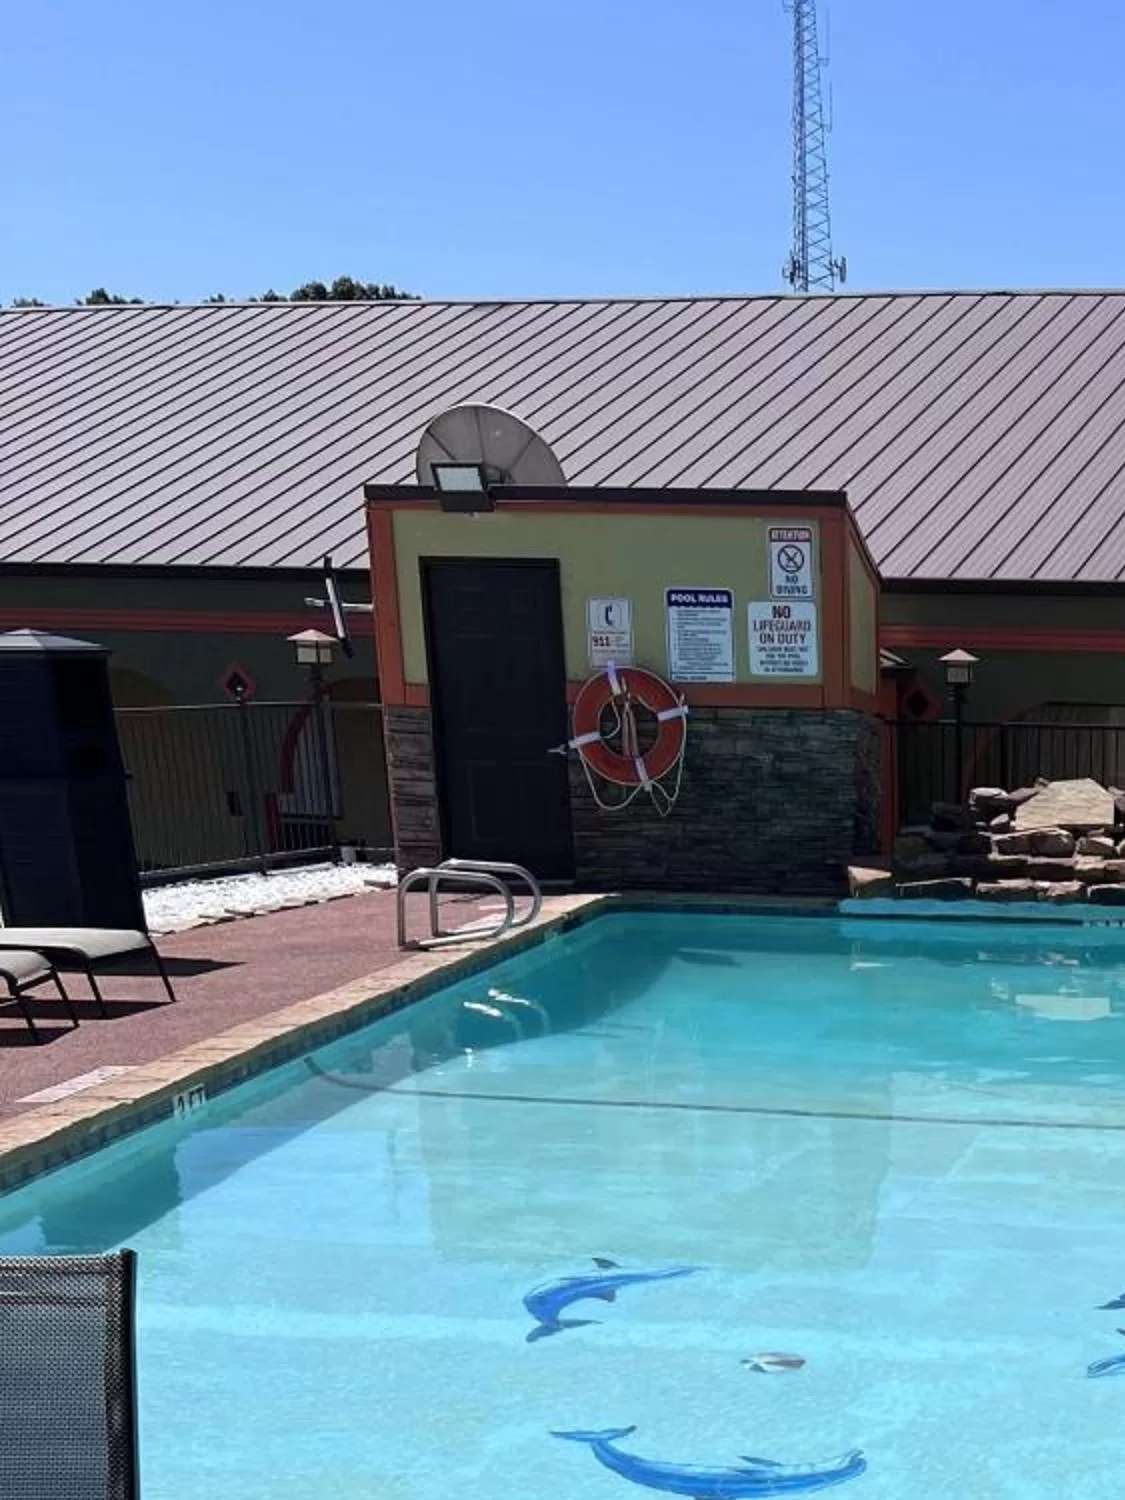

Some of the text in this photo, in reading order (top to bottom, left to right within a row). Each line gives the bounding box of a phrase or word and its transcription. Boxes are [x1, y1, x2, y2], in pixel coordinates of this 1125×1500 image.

[785, 575, 798, 583] NO
[670, 593, 729, 603] POOL RULES
[772, 605, 791, 618] NO
[753, 619, 811, 632] LIFEGUARD
[759, 633, 806, 644] ON DUTY
